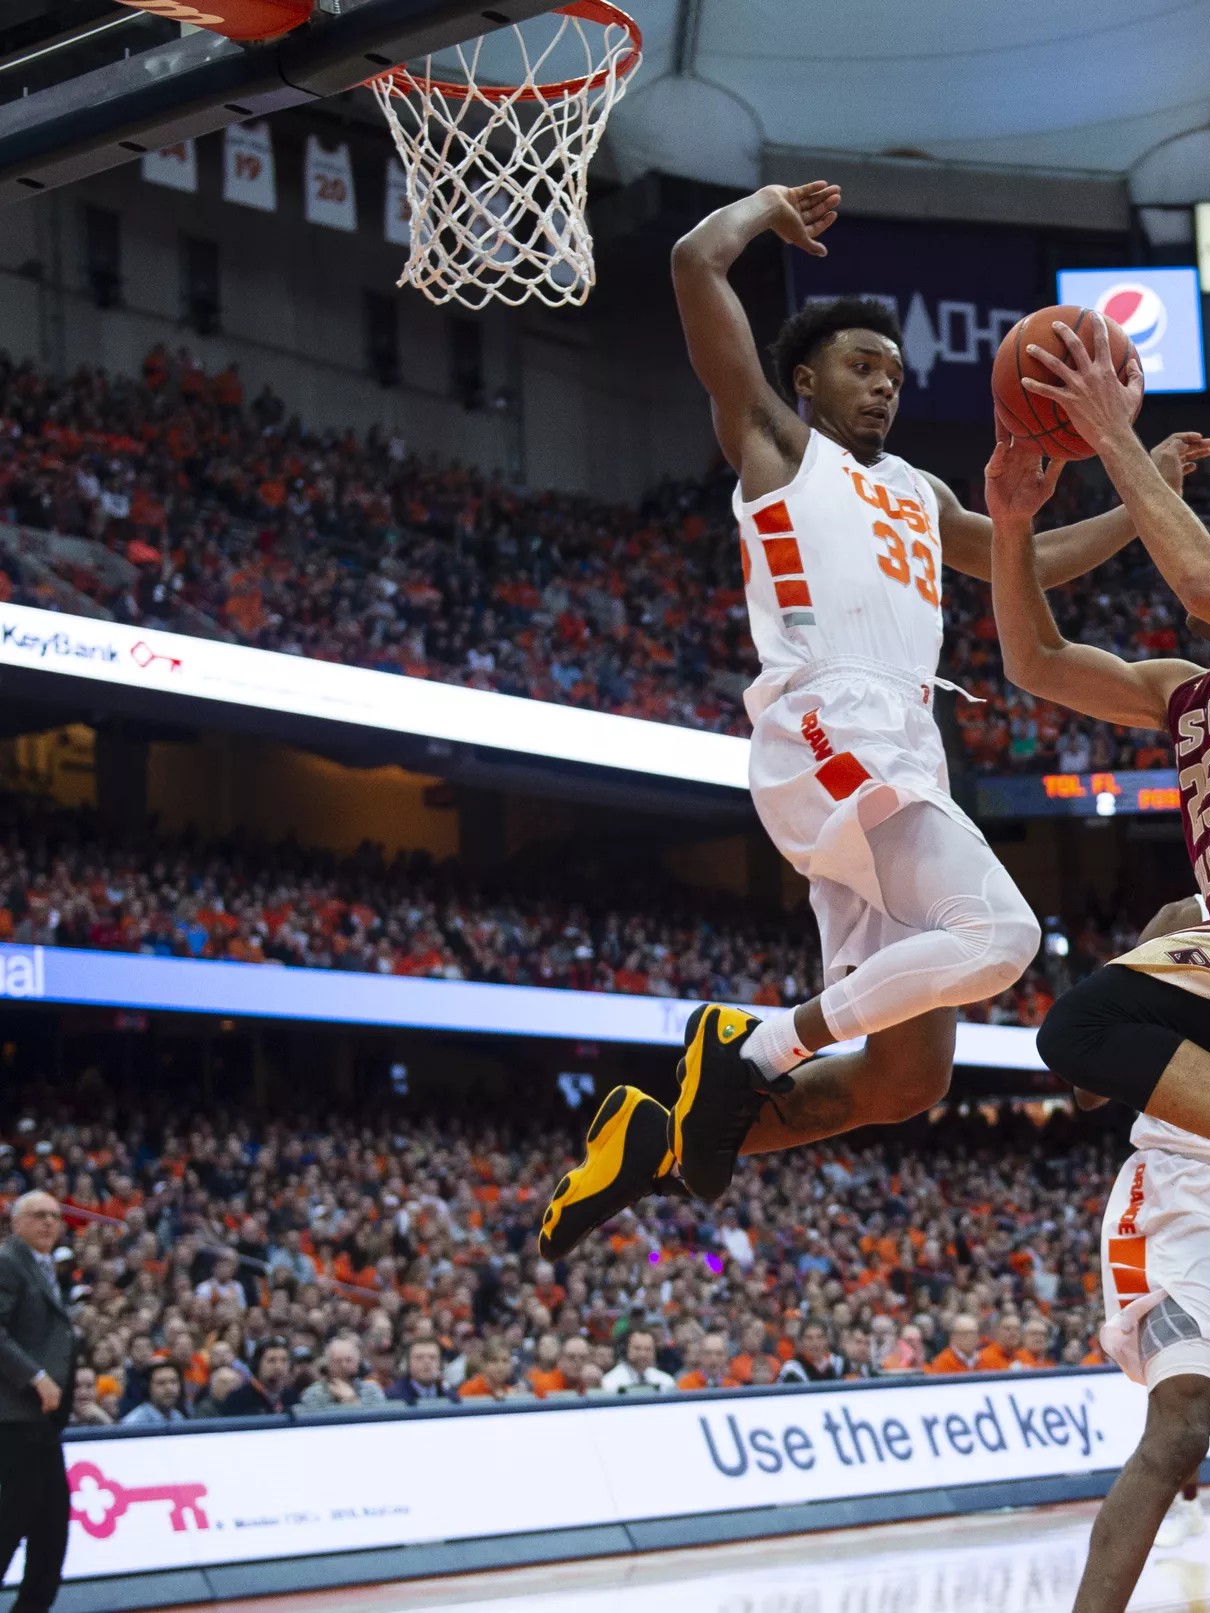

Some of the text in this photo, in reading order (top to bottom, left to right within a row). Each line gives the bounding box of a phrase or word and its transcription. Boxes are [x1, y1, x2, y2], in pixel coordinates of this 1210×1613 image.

[872, 520, 940, 610] 33
[2, 623, 118, 663] KeyBank
[699, 1411, 816, 1478] Use
[823, 1406, 912, 1466] the
[921, 1396, 1007, 1457] red
